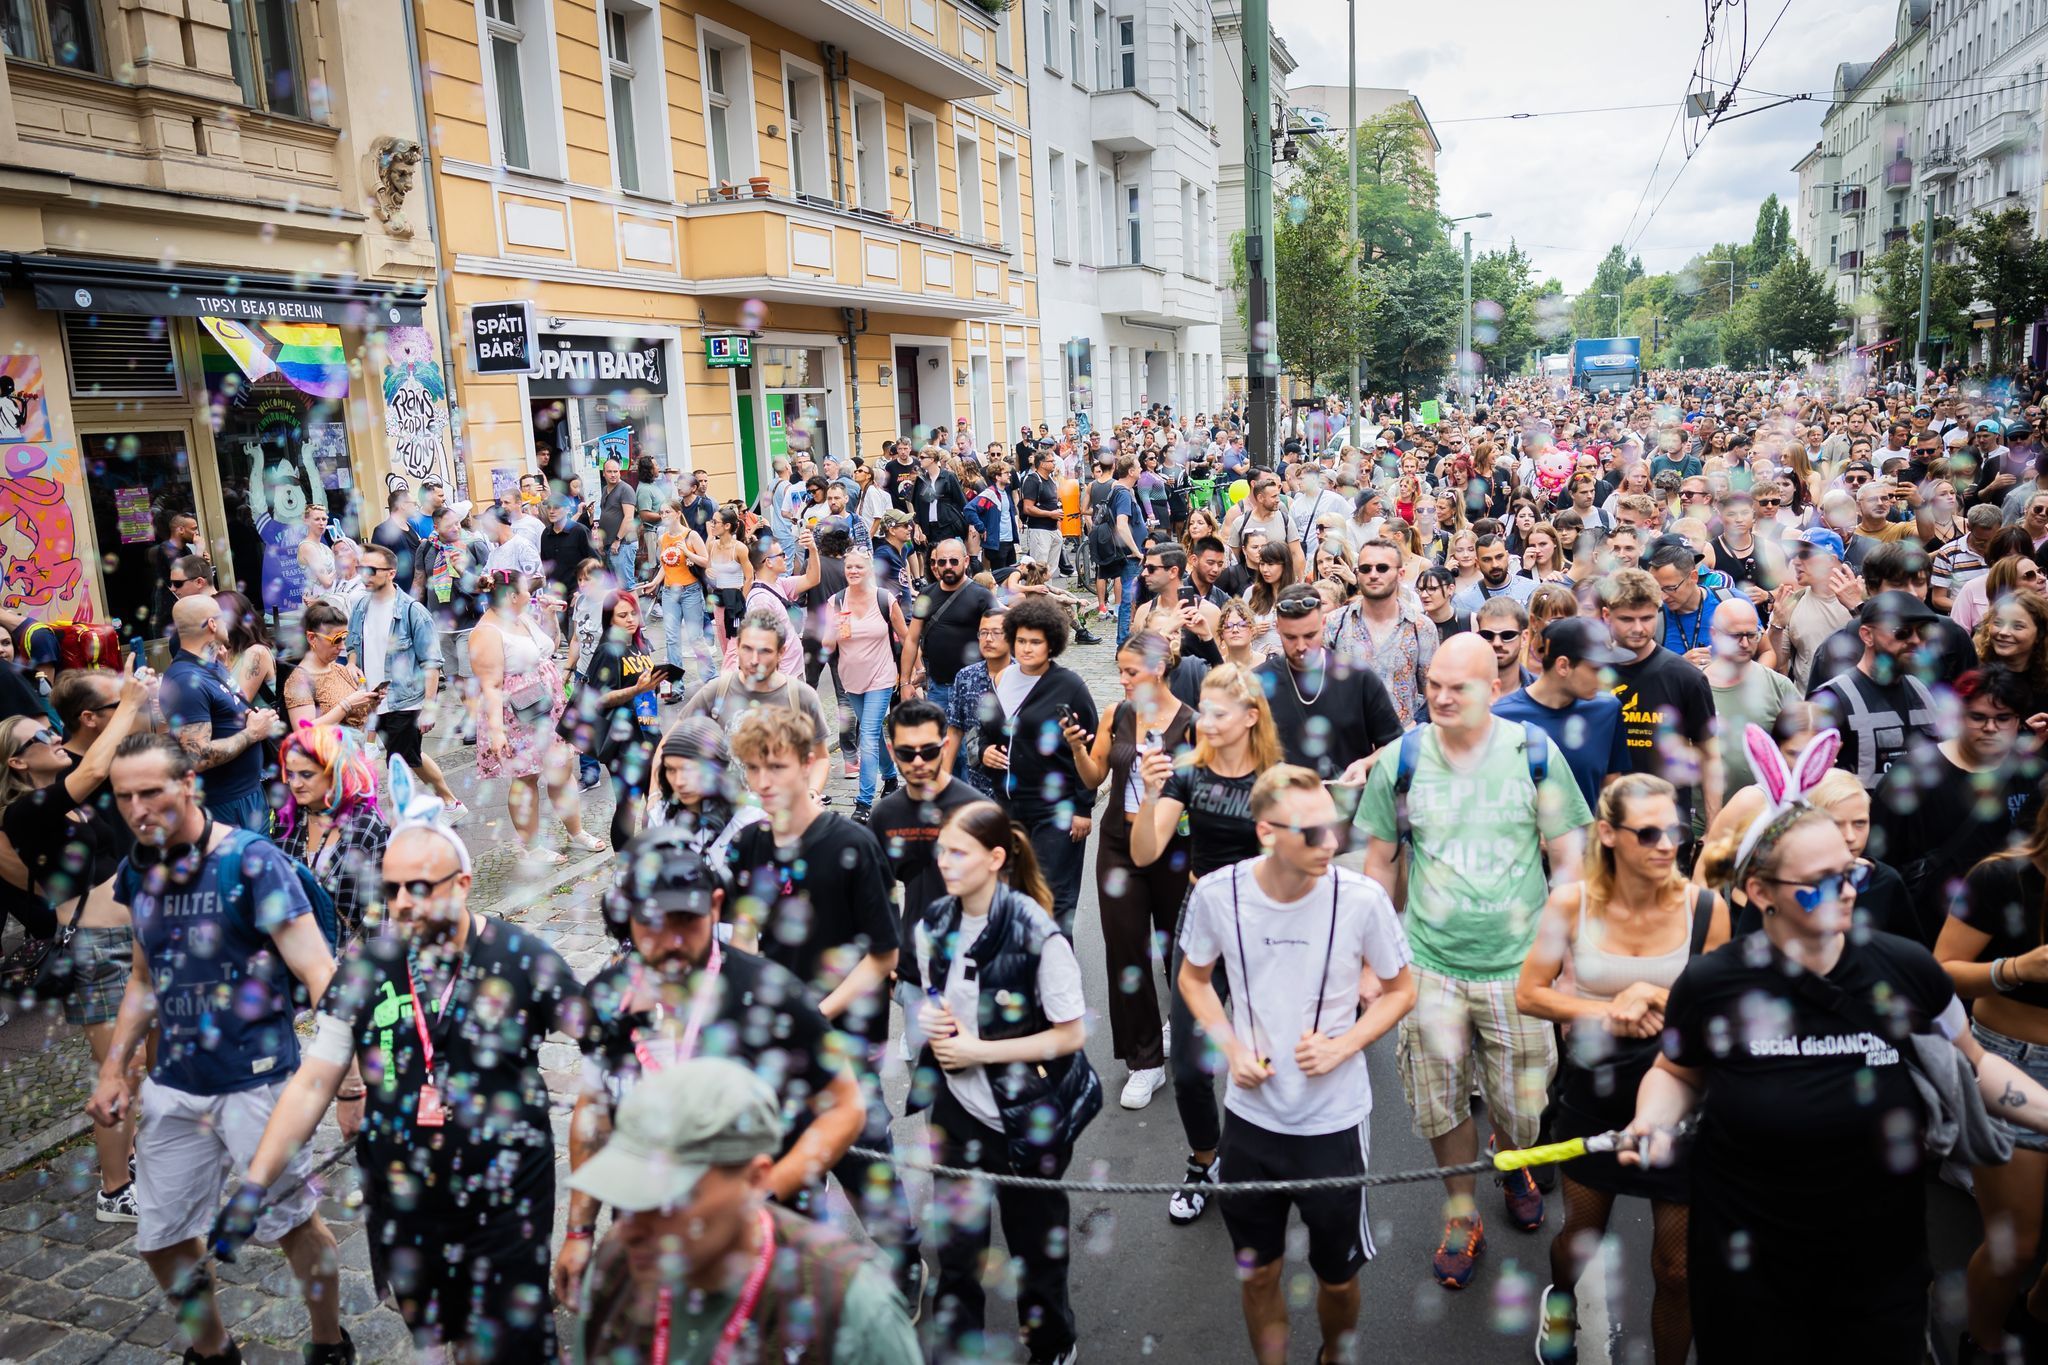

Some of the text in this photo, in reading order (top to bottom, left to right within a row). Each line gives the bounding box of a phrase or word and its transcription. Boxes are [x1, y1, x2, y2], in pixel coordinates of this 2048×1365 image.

[196, 297, 237, 313] TIPSY
[278, 302, 323, 319] BERLIN
[476, 313, 523, 335] SPÄTI
[479, 337, 515, 359] BÄR
[598, 342, 647, 380] BÄR
[257, 398, 297, 415] WELCOMING
[1750, 1033, 1800, 1056] social
